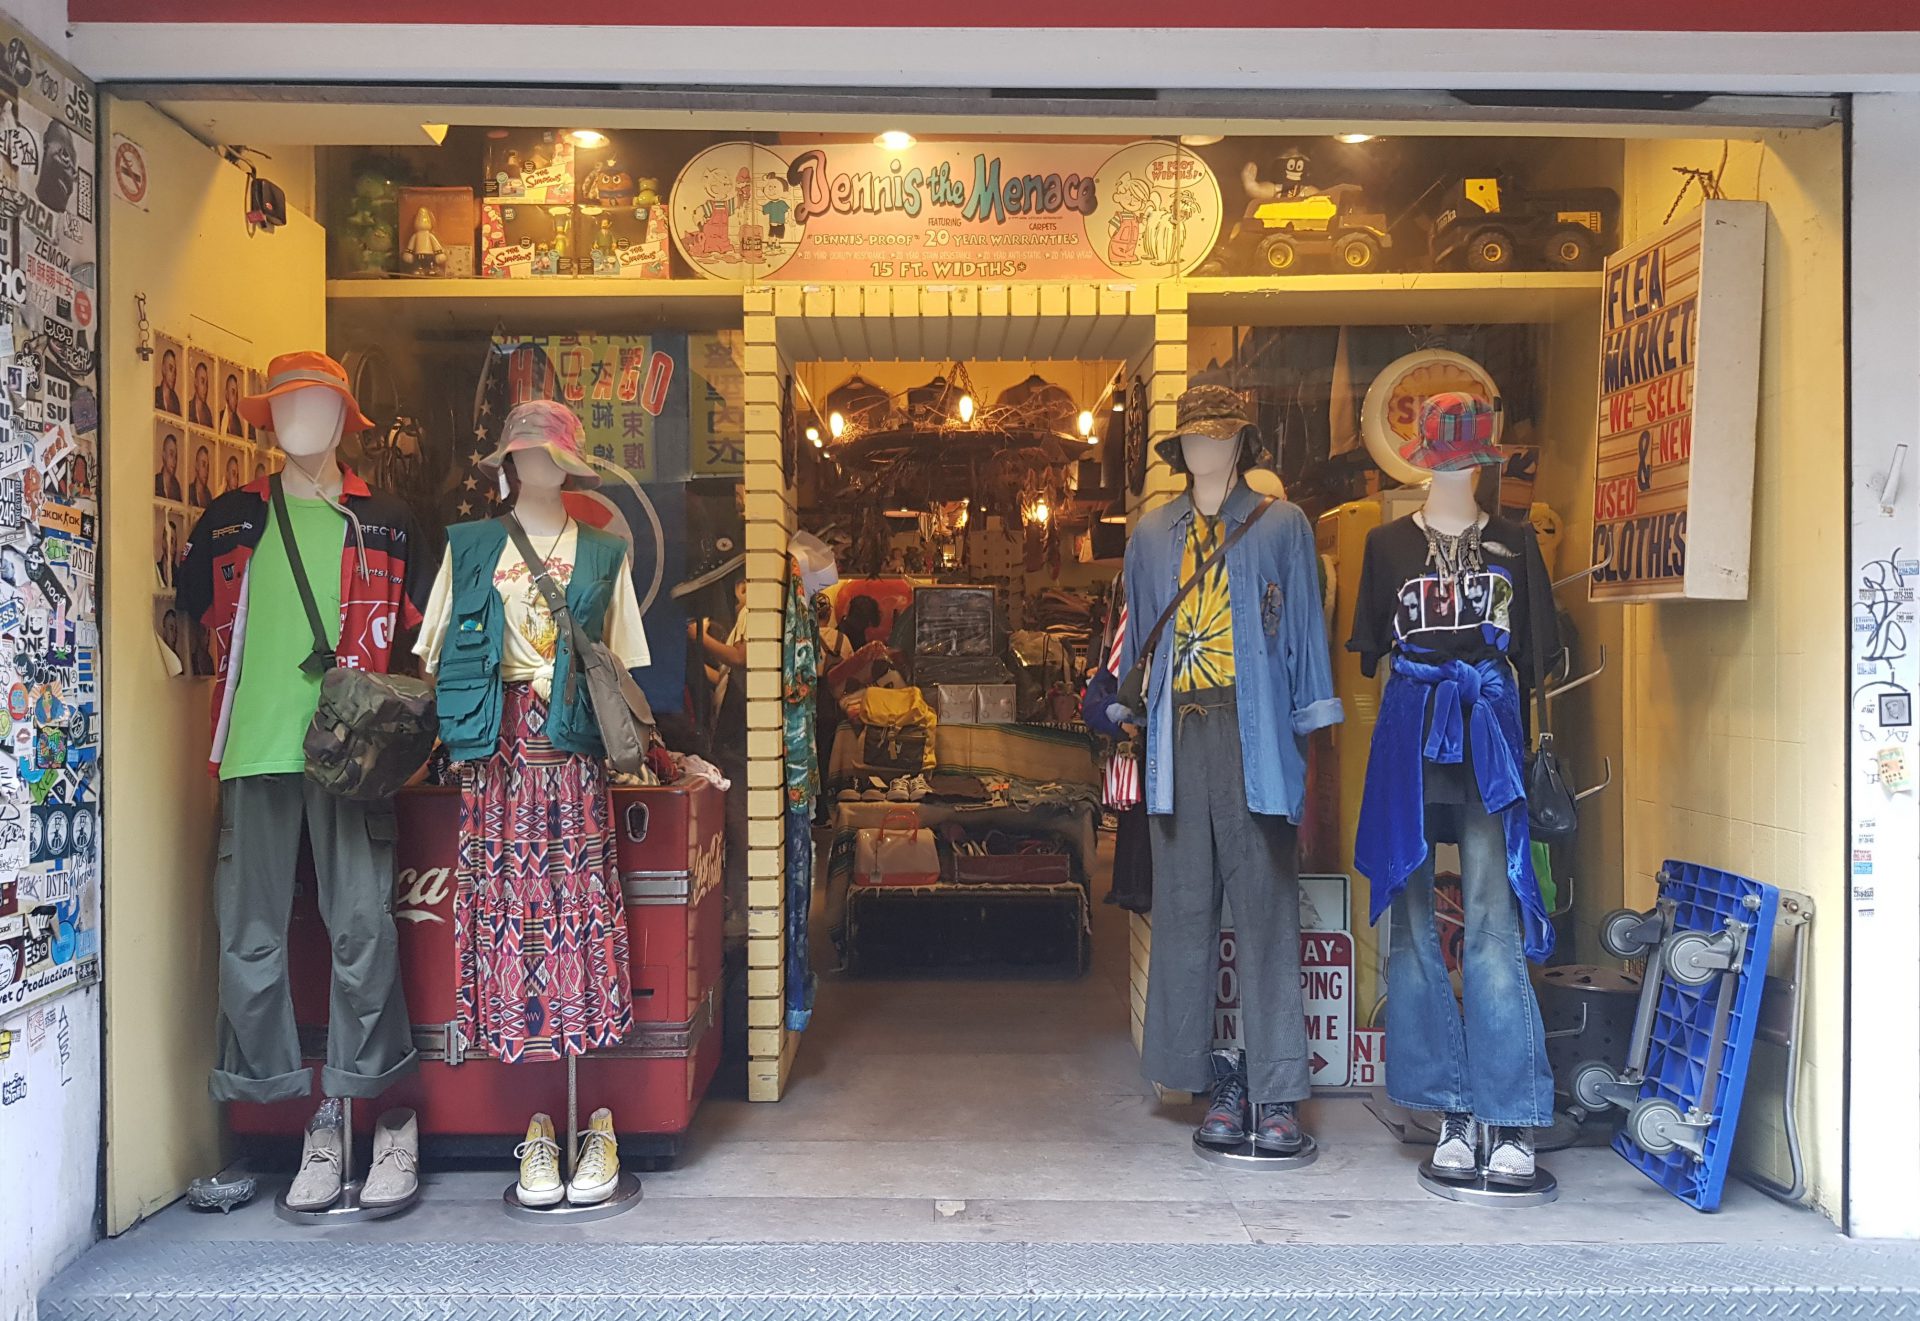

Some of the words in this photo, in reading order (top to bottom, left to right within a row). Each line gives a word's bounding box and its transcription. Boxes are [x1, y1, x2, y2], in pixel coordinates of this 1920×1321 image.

[65, 103, 92, 134] ONE
[787, 149, 924, 225] Dennis
[927, 160, 965, 208] the
[961, 153, 1099, 225] Menace
[923, 229, 950, 247] 20
[953, 233, 988, 247] YEAR
[990, 232, 1080, 247] WARRANTIES
[928, 217, 962, 227] FEATURING
[1029, 222, 1057, 231] CARPETS
[35, 236, 70, 272] ZEMOK
[871, 261, 894, 278] 15
[899, 261, 928, 278] FT.
[1608, 247, 1666, 330] FLEA
[1604, 307, 1695, 393] MARKET
[47, 378, 67, 400] KU
[1609, 389, 1634, 434] WE
[1646, 372, 1687, 422] SELL
[47, 402, 67, 422] SU
[1659, 417, 1691, 463] NEW
[1637, 430, 1652, 491] &
[1595, 476, 1637, 520] USED
[72, 545, 94, 574] DSTR
[1593, 511, 1687, 583] CLOTHES
[46, 871, 69, 898] DSTR
[17, 965, 74, 1003] Production
